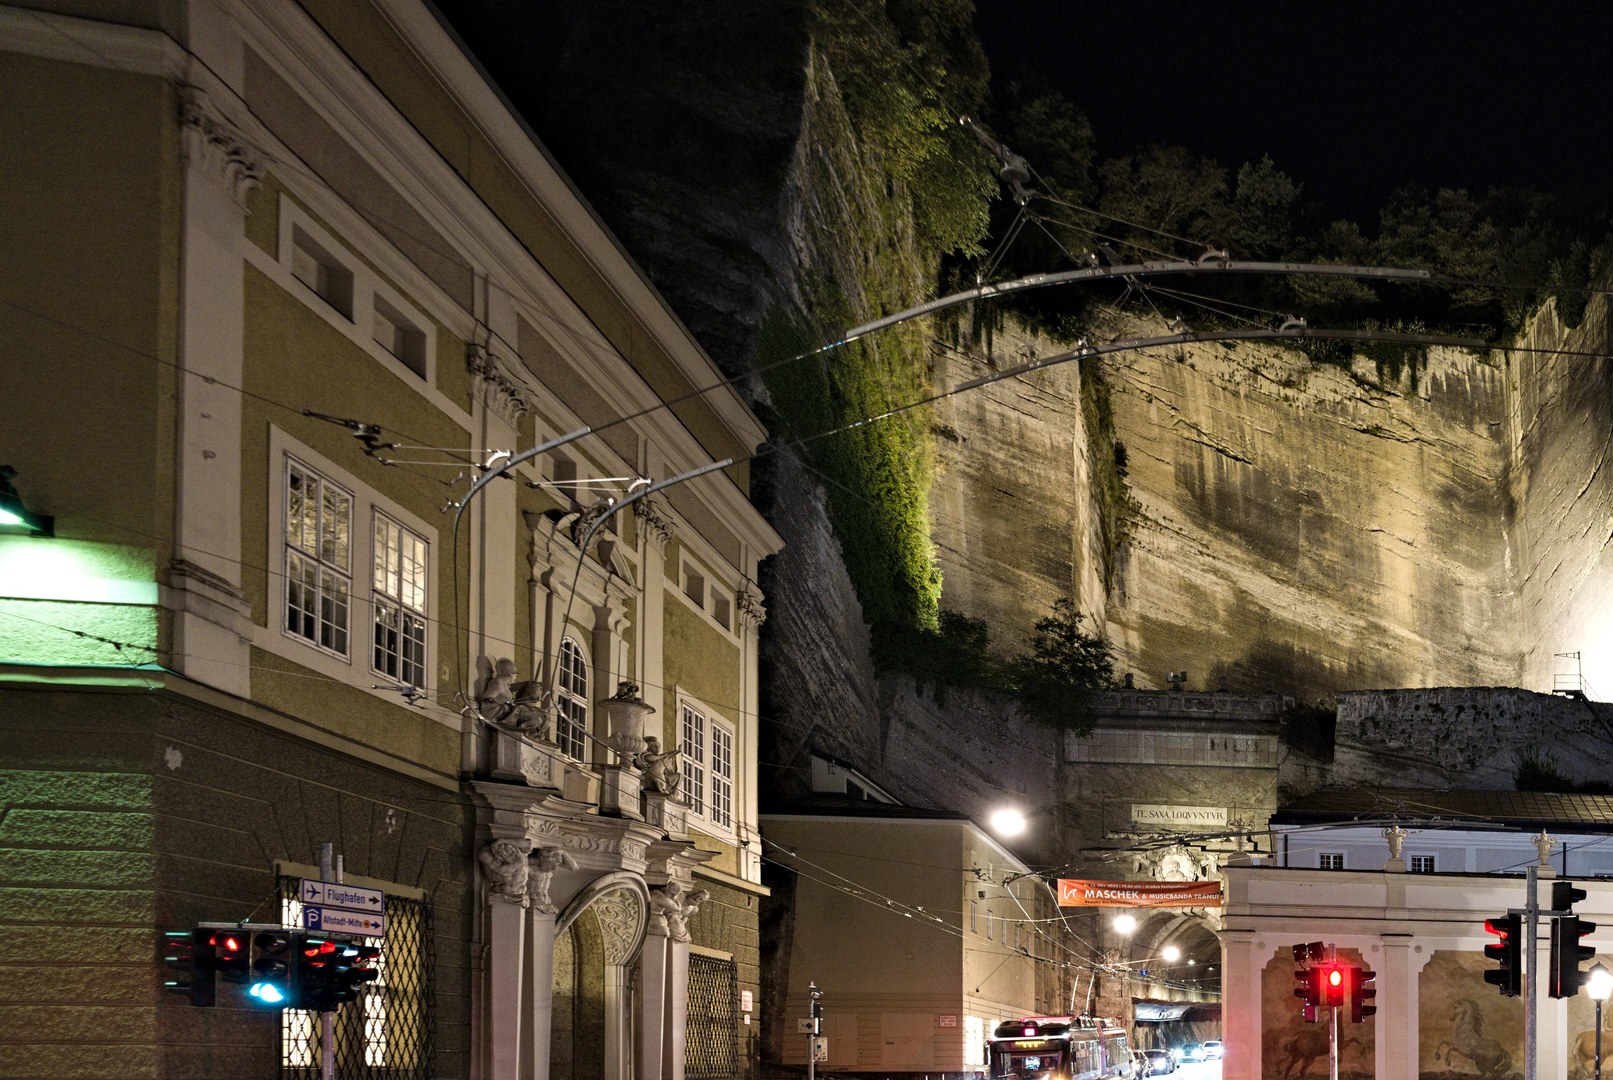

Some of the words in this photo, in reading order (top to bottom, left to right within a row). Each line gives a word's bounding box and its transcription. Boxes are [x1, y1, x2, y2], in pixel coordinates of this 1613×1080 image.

[327, 889, 367, 905] Flughafen
[1084, 889, 1139, 899] MASCHEK
[323, 915, 363, 928] Altstadt-Mitte
